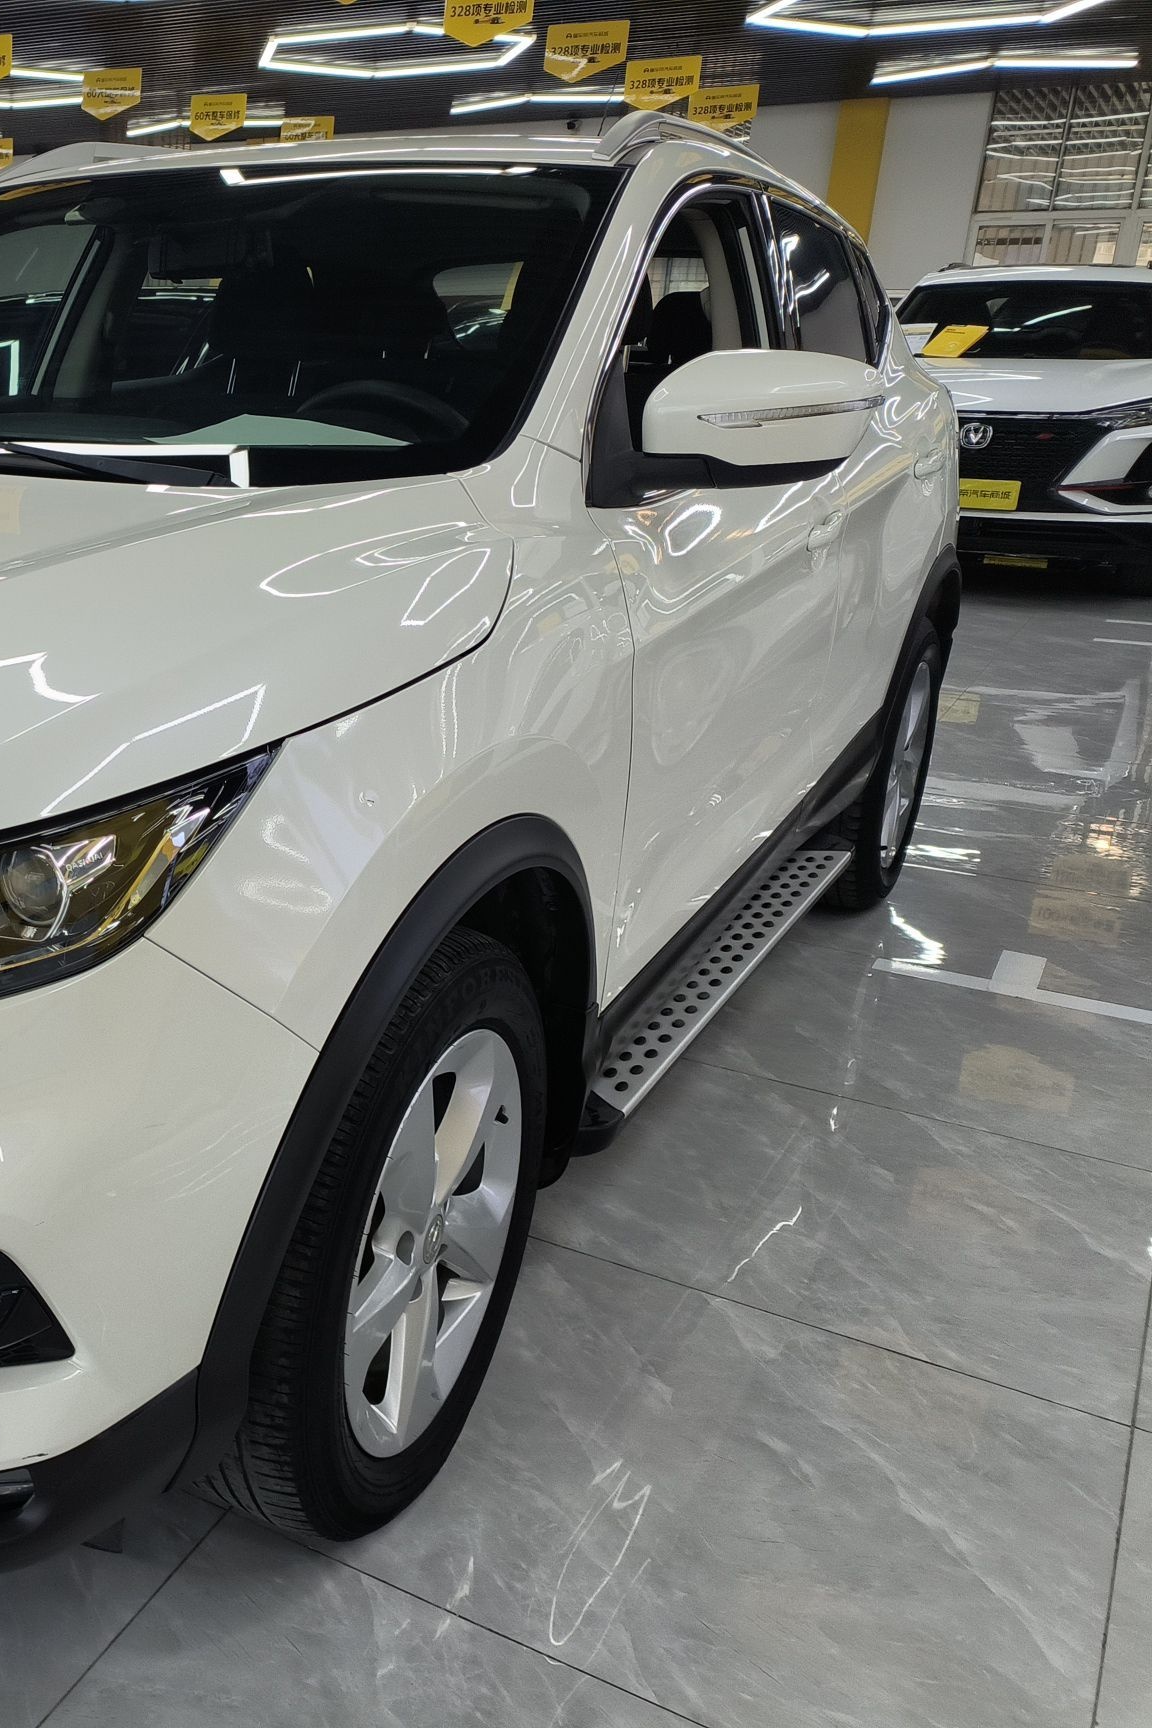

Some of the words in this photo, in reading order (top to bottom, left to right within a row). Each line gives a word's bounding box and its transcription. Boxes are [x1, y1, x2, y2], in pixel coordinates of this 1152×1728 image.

[450, 0, 528, 18] 328项专业检测
[551, 42, 622, 57] 328项专业检测
[629, 75, 695, 89] 328项专业检测
[194, 110, 241, 121] 60天整车保修
[692, 101, 753, 116] 328项专业检测
[66, 852, 103, 871] QASAI
